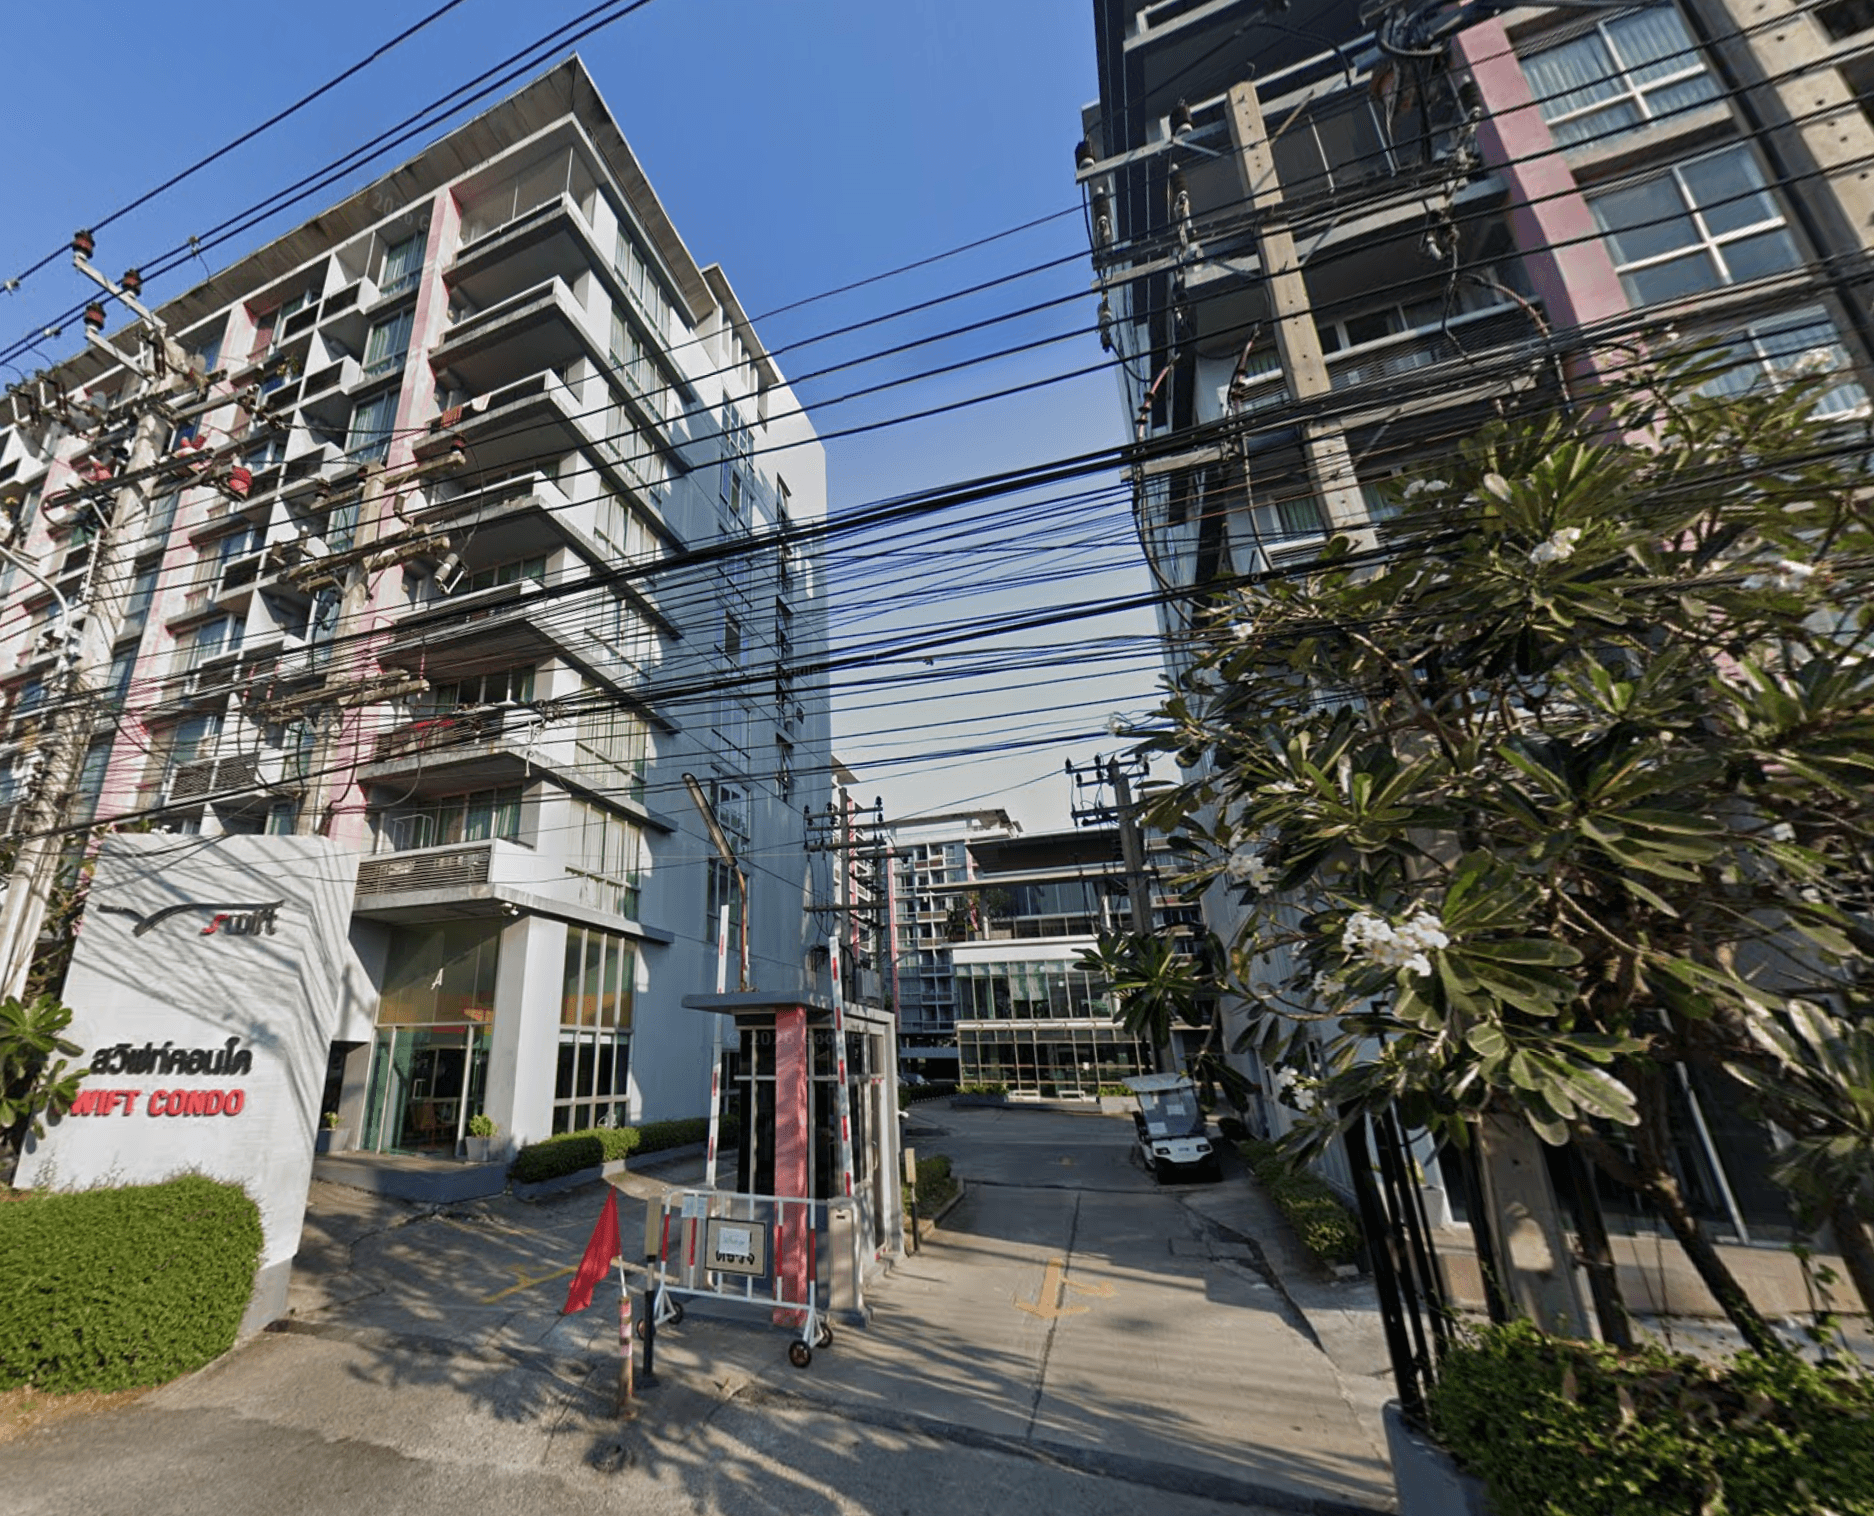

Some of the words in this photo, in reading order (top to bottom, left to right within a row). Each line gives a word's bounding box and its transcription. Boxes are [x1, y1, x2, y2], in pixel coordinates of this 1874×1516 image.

[430, 967, 444, 990] A
[89, 1036, 253, 1075] สวิฟท์คอนโด
[70, 1089, 143, 1116] WIFT
[148, 1088, 246, 1117] CONDO
